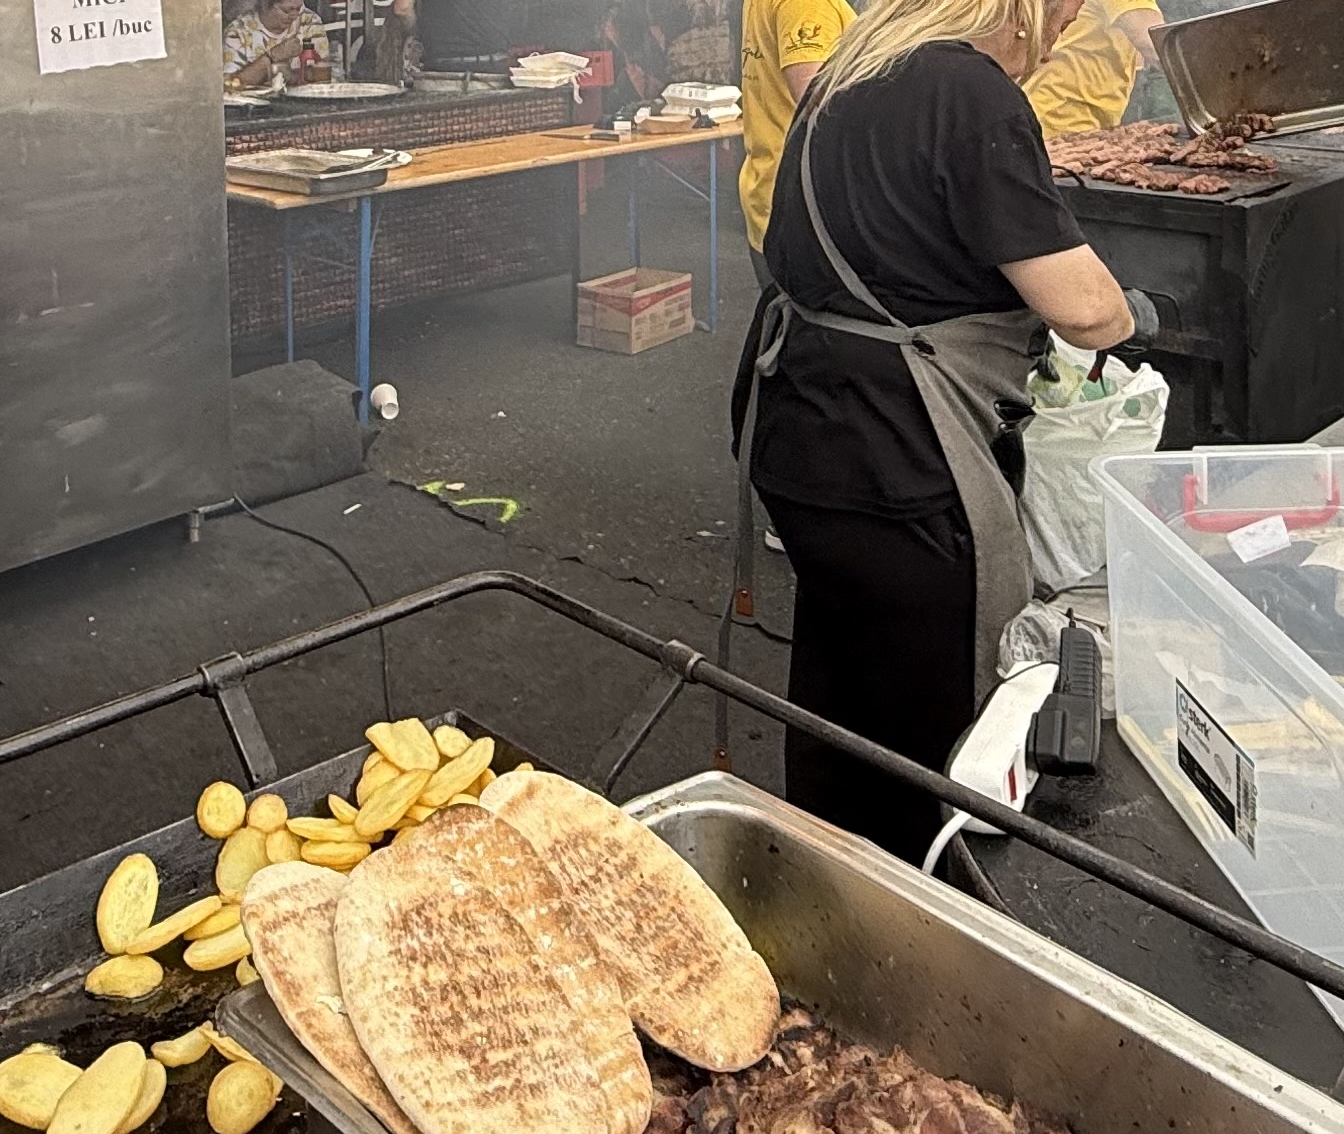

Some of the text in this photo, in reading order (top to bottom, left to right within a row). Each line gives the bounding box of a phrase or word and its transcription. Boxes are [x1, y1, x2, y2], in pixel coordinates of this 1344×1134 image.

[50, 18, 153, 44] 8 LEI /buc
